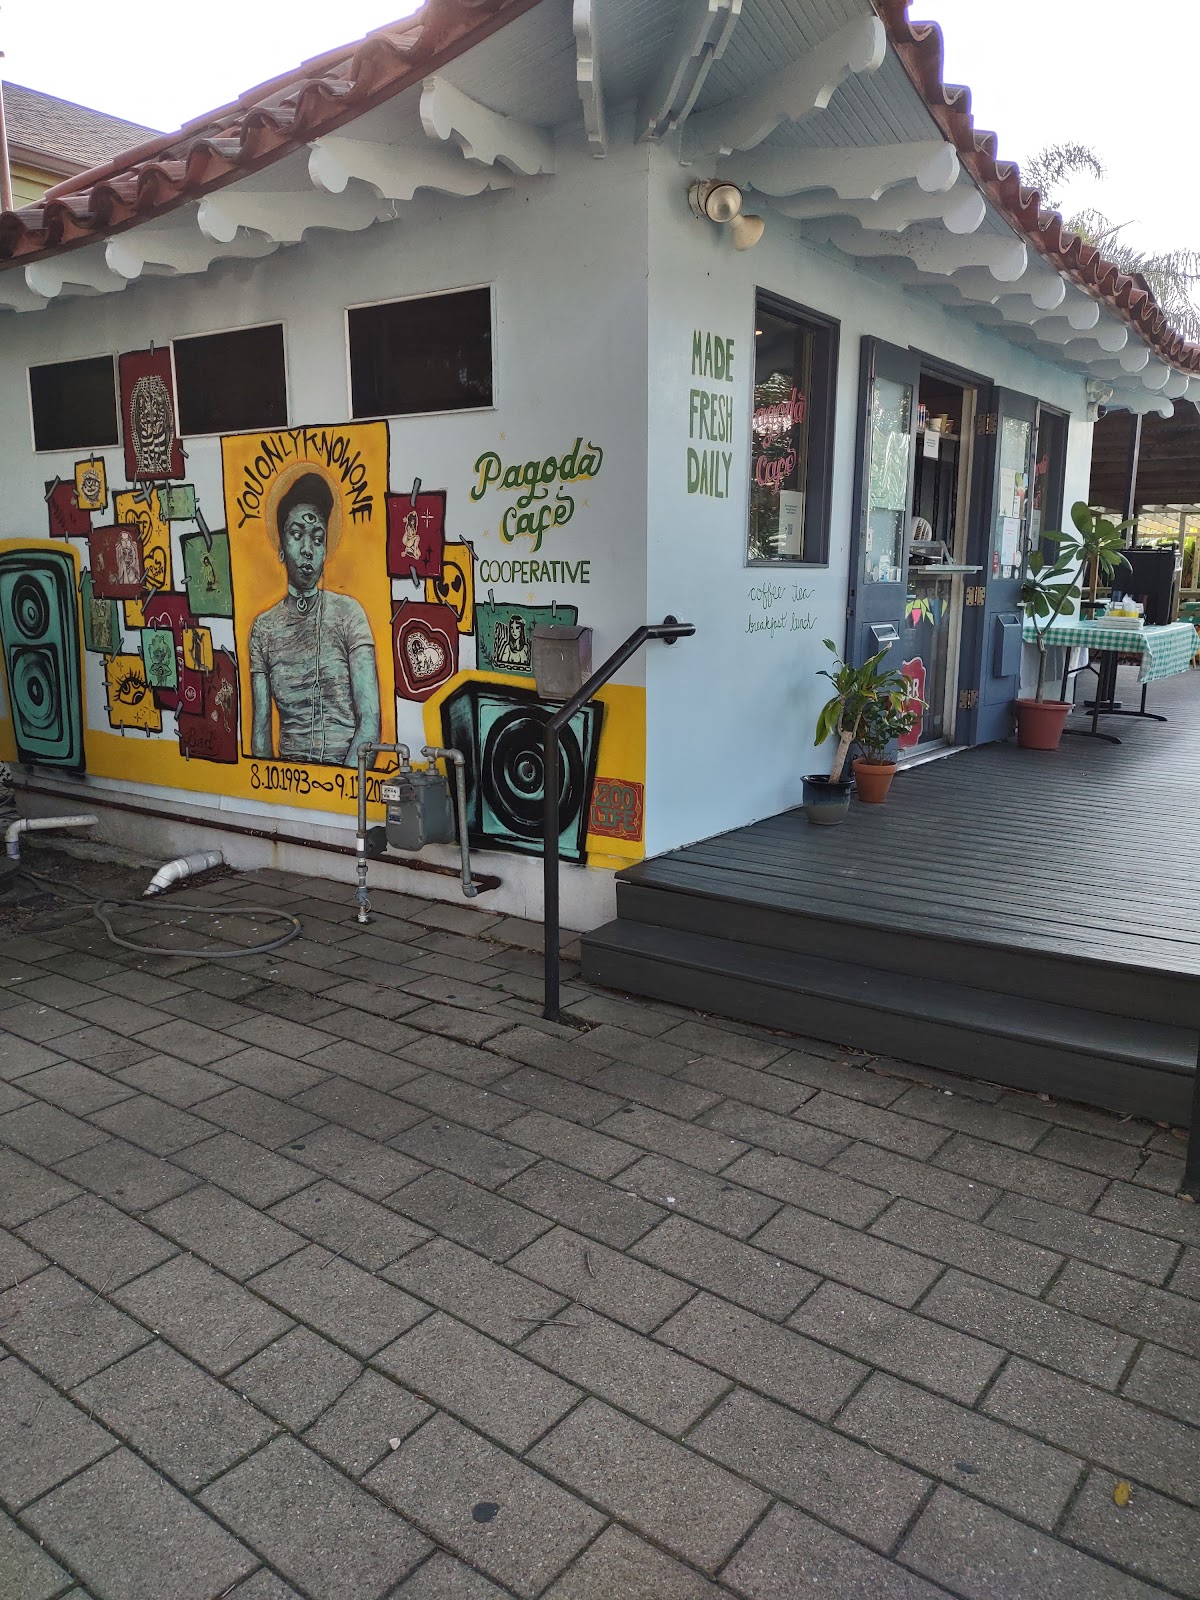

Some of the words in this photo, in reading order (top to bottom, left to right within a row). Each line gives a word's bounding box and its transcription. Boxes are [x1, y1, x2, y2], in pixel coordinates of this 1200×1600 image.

[691, 329, 735, 382] MADE
[689, 388, 733, 444] FRESH
[470, 437, 603, 509] Pagoda
[687, 447, 733, 499] DAILY
[480, 559, 591, 584] COOPERATIVE
[748, 582, 786, 610] coffee
[791, 583, 816, 602] tea
[745, 612, 788, 639] breakfast
[790, 612, 818, 631] lunch
[250, 763, 311, 795] 8.10.1993
[591, 806, 635, 830] LIFE
